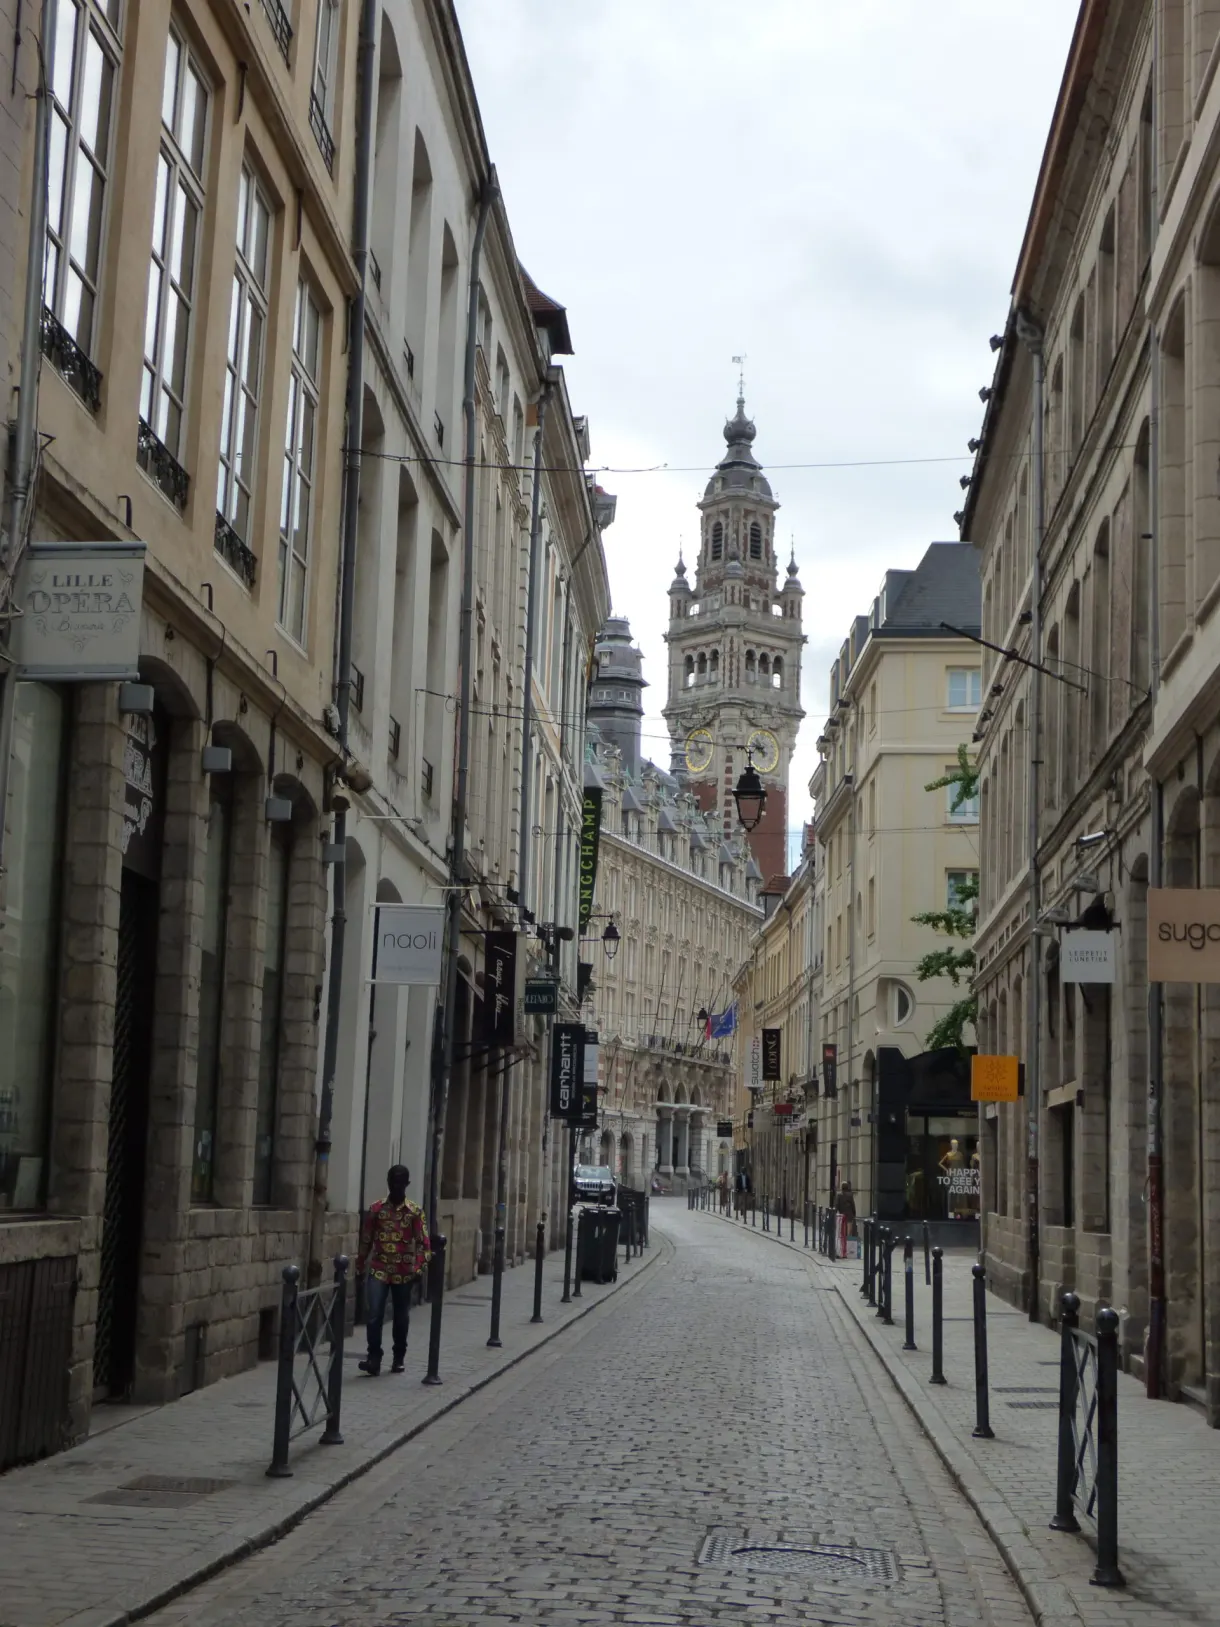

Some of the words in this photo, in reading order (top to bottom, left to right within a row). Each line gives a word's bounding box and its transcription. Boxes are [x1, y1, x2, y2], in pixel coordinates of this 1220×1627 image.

[52, 574, 113, 587] LILLE
[27, 587, 136, 614] OPÉRA
[383, 931, 437, 950] naoli
[558, 1032, 571, 1110] carhartt
[750, 1048, 760, 1085] swatch
[937, 1176, 950, 1185] TO
[952, 1177, 972, 1185] SEE
[948, 1185, 980, 1194] AGAIN
